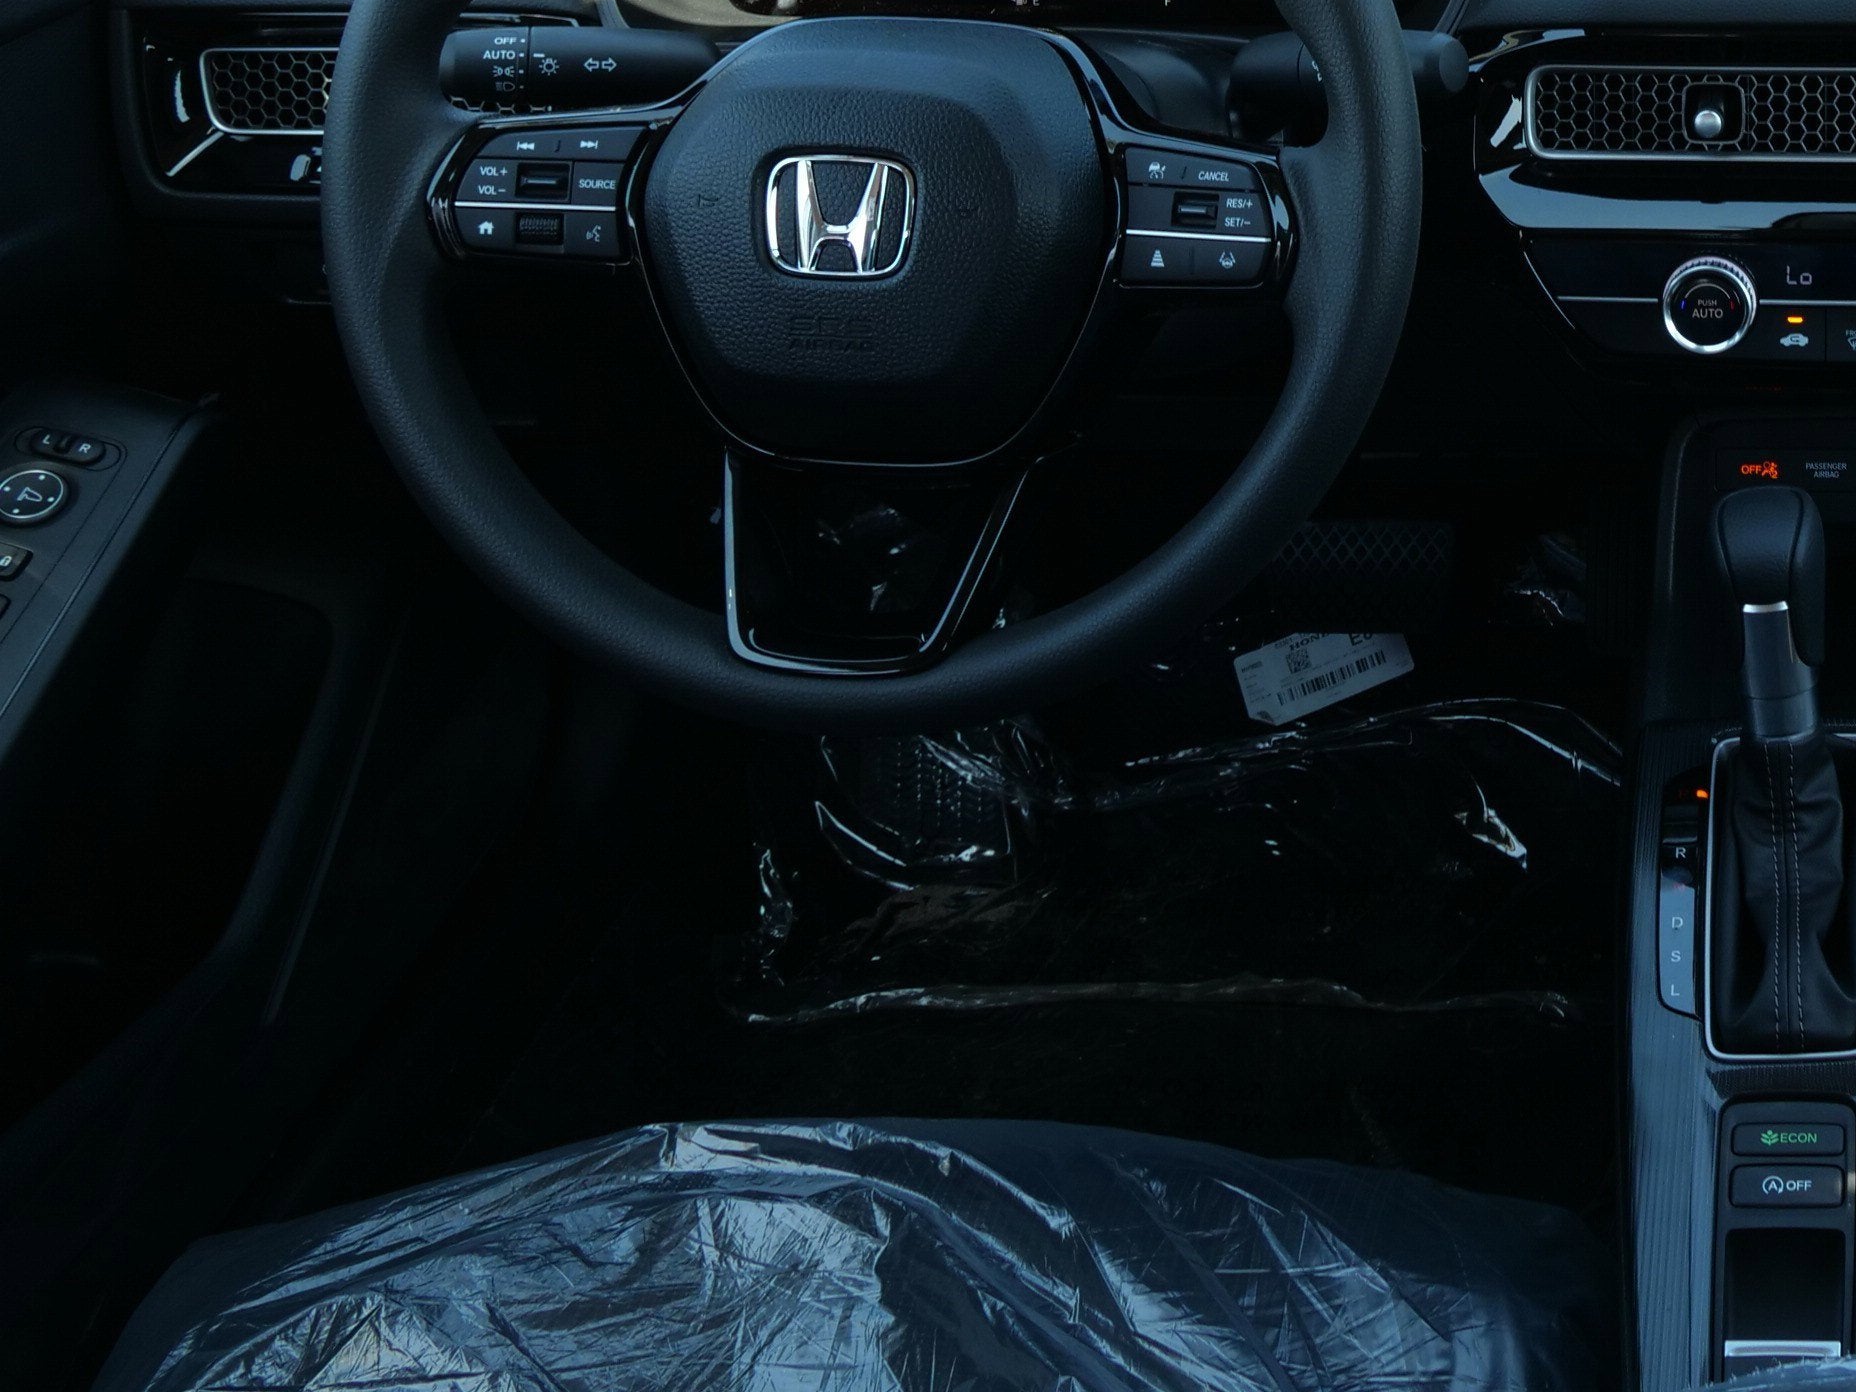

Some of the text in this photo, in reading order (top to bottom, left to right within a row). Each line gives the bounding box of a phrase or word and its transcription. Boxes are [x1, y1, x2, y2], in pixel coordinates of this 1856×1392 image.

[494, 36, 517, 45] OFF
[483, 50, 516, 60] AUTO
[1198, 171, 1230, 182] CANCEL
[579, 179, 616, 190] SOURCE
[1786, 265, 1813, 286] Lo
[1697, 299, 1717, 307] PUSH
[1692, 309, 1724, 319] AUTO
[42, 434, 51, 445] L
[79, 443, 91, 454] R
[1740, 464, 1761, 475] OFF
[1813, 471, 1840, 479] AIRBAG
[1675, 847, 1687, 859] R
[1672, 917, 1683, 930] D
[1670, 950, 1681, 963] S
[1670, 984, 1680, 997] L
[1780, 1132, 1817, 1144] ECON
[1786, 1180, 1812, 1191] OFF
